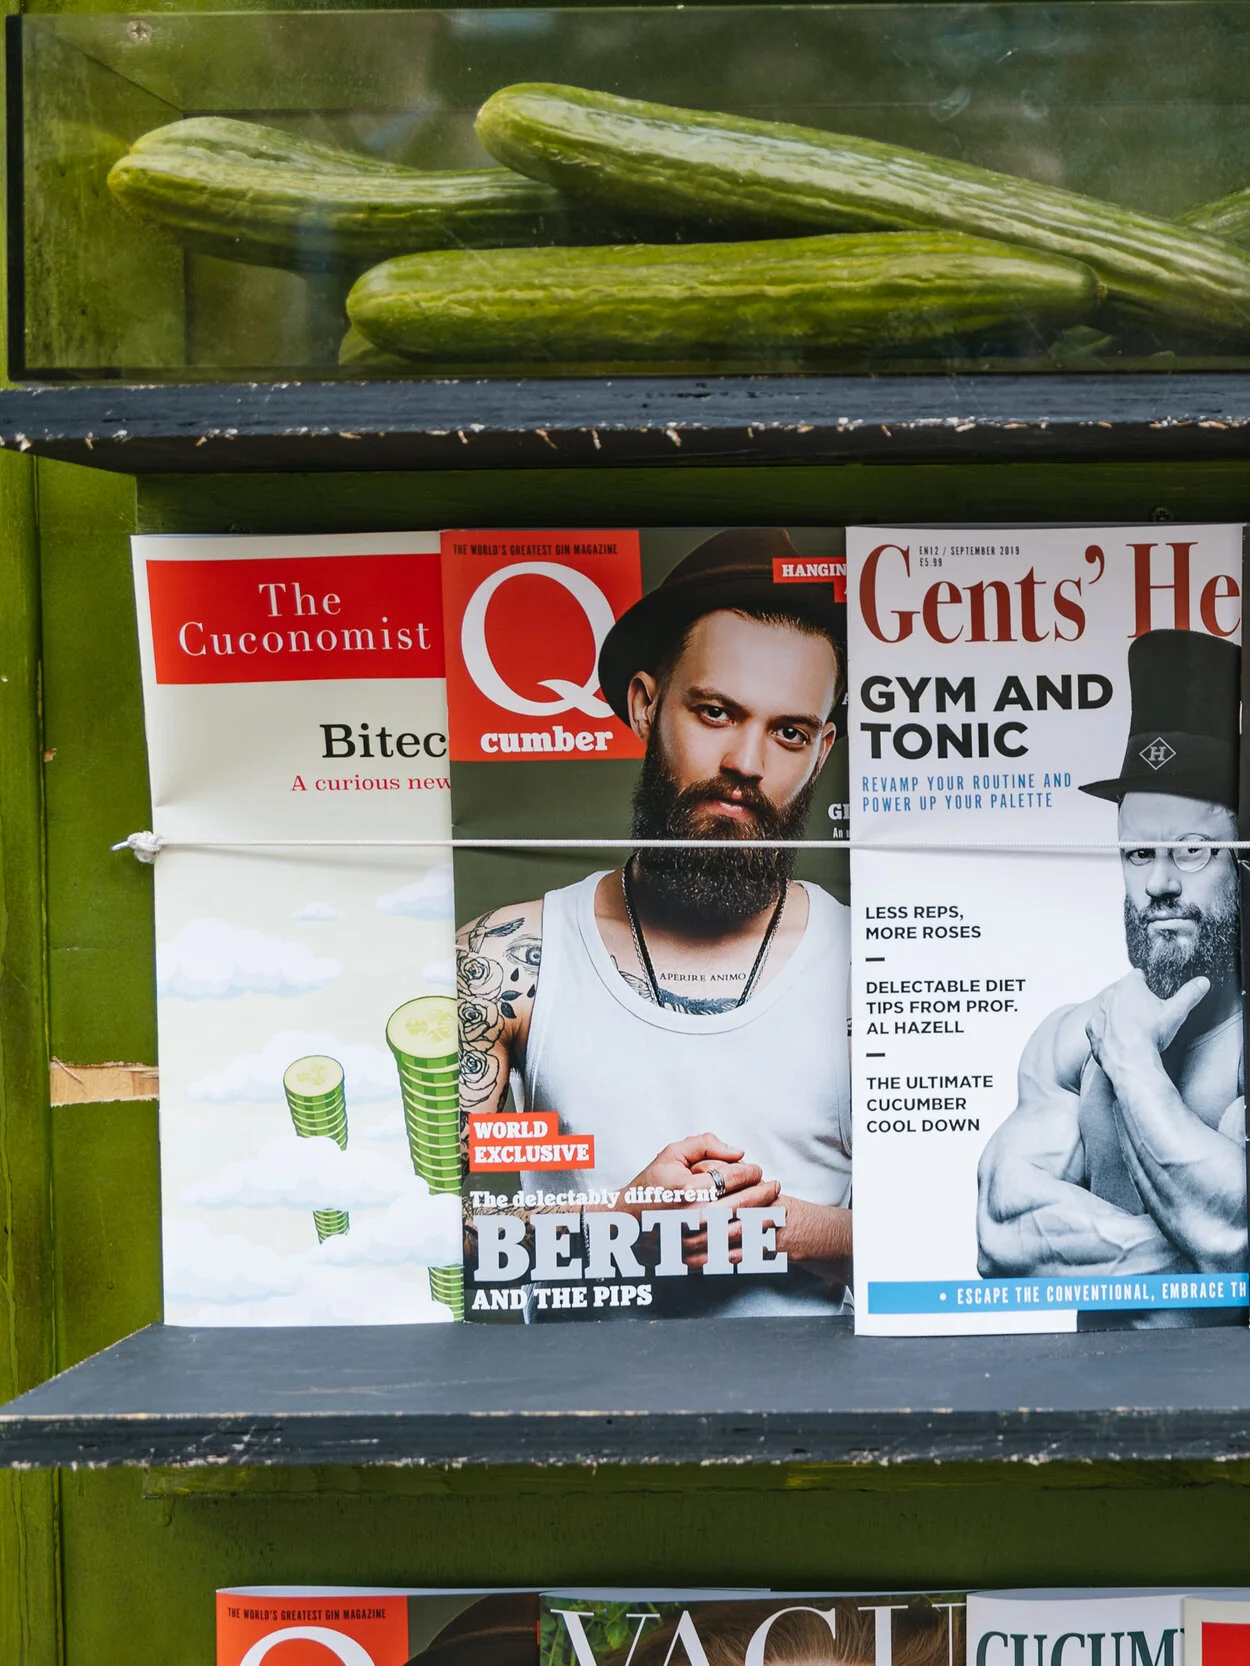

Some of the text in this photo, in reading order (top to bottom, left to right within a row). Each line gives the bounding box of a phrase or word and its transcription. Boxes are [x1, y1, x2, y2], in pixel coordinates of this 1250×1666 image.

[453, 544, 617, 556] THE WORLD'S GREATEST GIN MAGAZINE
[950, 546, 996, 555] SEPTEMBER
[999, 546, 1020, 555] 2019
[259, 582, 341, 617] The
[859, 542, 1241, 644] Gents' He
[179, 616, 431, 656] Cuconomist
[461, 561, 616, 718] Q
[860, 673, 1113, 714] GYM AND
[319, 723, 447, 758] Bitec
[480, 726, 613, 753] cumber
[860, 721, 1030, 760] TONIC
[291, 776, 307, 791] A
[315, 774, 400, 791] curious
[862, 773, 1072, 792] REVAMP YOUR ROUTINE AND
[863, 793, 1053, 812] POWER UP YOUR PALETTE
[866, 906, 964, 921] LESS REPS,
[866, 926, 981, 940] MORE ROSES
[660, 973, 746, 982] APERIRE ANIMO
[866, 979, 1026, 994] DELECTABLE DIET
[866, 1000, 1018, 1014] TIPS FROM PROF.
[867, 1021, 965, 1035] AL HAZELL
[866, 1075, 994, 1090] THE ULTIMATE
[867, 1097, 967, 1111] CUCUMBER
[473, 1121, 548, 1139] WORLD
[867, 1119, 980, 1133] COOL DOWN
[474, 1144, 589, 1163] EXCLUSIVE
[471, 1186, 719, 1208] The delectably different
[474, 1207, 788, 1282] BERTIE
[471, 1285, 652, 1310] AND THE PIPS
[957, 1281, 1247, 1305] ESCAPE THE CONVENTIONAL, EMBRACE TH
[228, 1608, 386, 1621] THE WORLD'S GREATEST GIN MAGAZINE
[976, 1628, 1184, 1666] CUCUM
